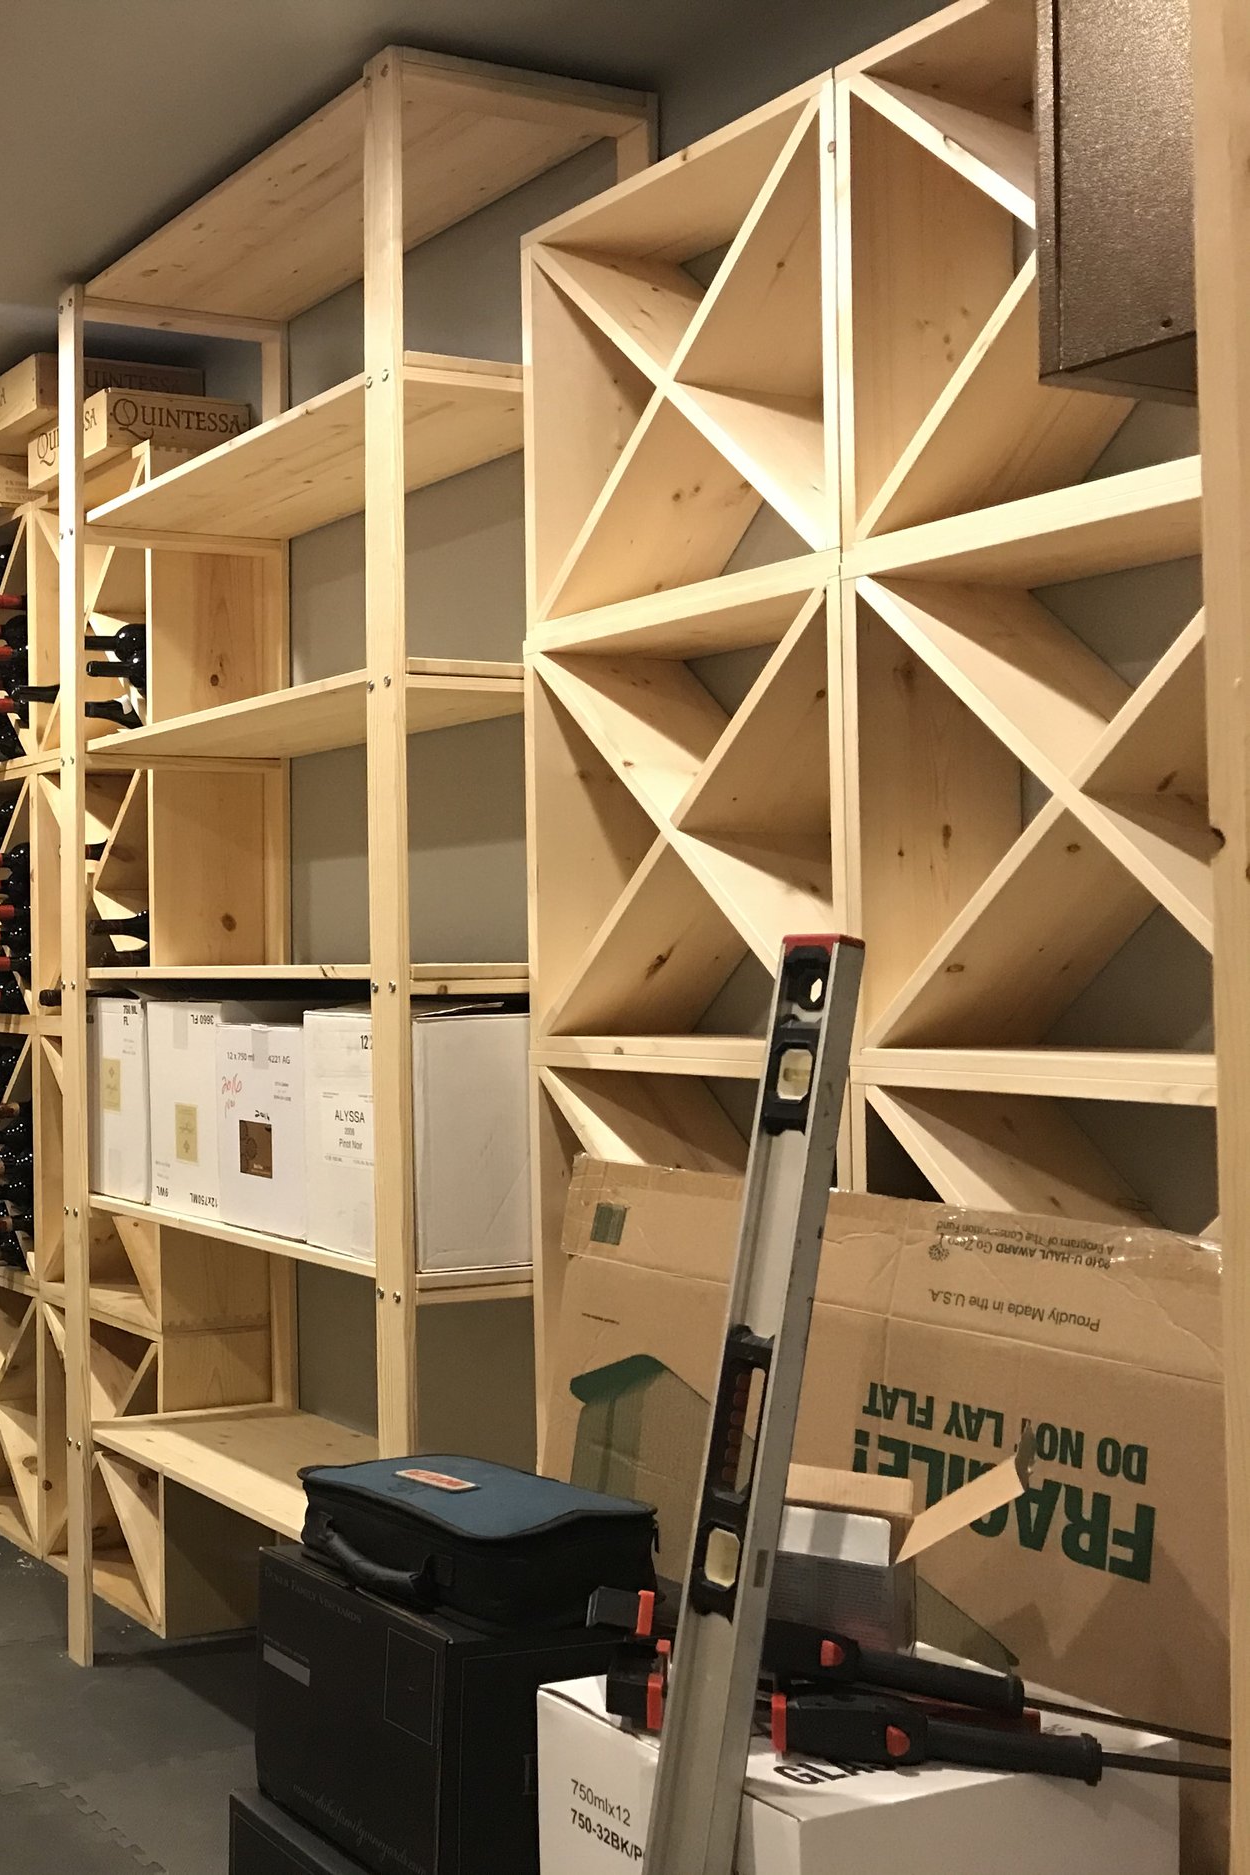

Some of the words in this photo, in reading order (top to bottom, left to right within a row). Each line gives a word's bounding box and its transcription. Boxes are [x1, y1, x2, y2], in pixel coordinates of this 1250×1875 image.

[113, 398, 242, 441] QUINTESSA
[359, 1034, 369, 1050] 12
[226, 1051, 234, 1061] 12
[238, 1052, 247, 1061] 750
[334, 1109, 366, 1124] ALYSSA
[936, 1220, 960, 1234] Fund
[975, 1240, 993, 1255] Go
[1025, 1231, 1045, 1247] The
[1047, 1237, 1058, 1247] of
[1059, 1238, 1105, 1254] Program
[995, 1242, 1037, 1258] AWARD
[1040, 1248, 1083, 1265] U-HAUL
[1106, 1244, 1115, 1256] A
[928, 1288, 966, 1308] U.S.A.
[968, 1294, 989, 1311] the
[992, 1299, 1004, 1311] in
[1007, 1301, 1045, 1323] Made
[1047, 1306, 1101, 1333] Proudly
[862, 1381, 935, 1431] FLAT
[943, 1401, 1005, 1449] LAY
[1014, 1418, 1085, 1470] NO
[1096, 1436, 1149, 1485] DO
[570, 1778, 632, 1827] 750mlx12
[570, 1807, 645, 1862] 750-32BK/P
